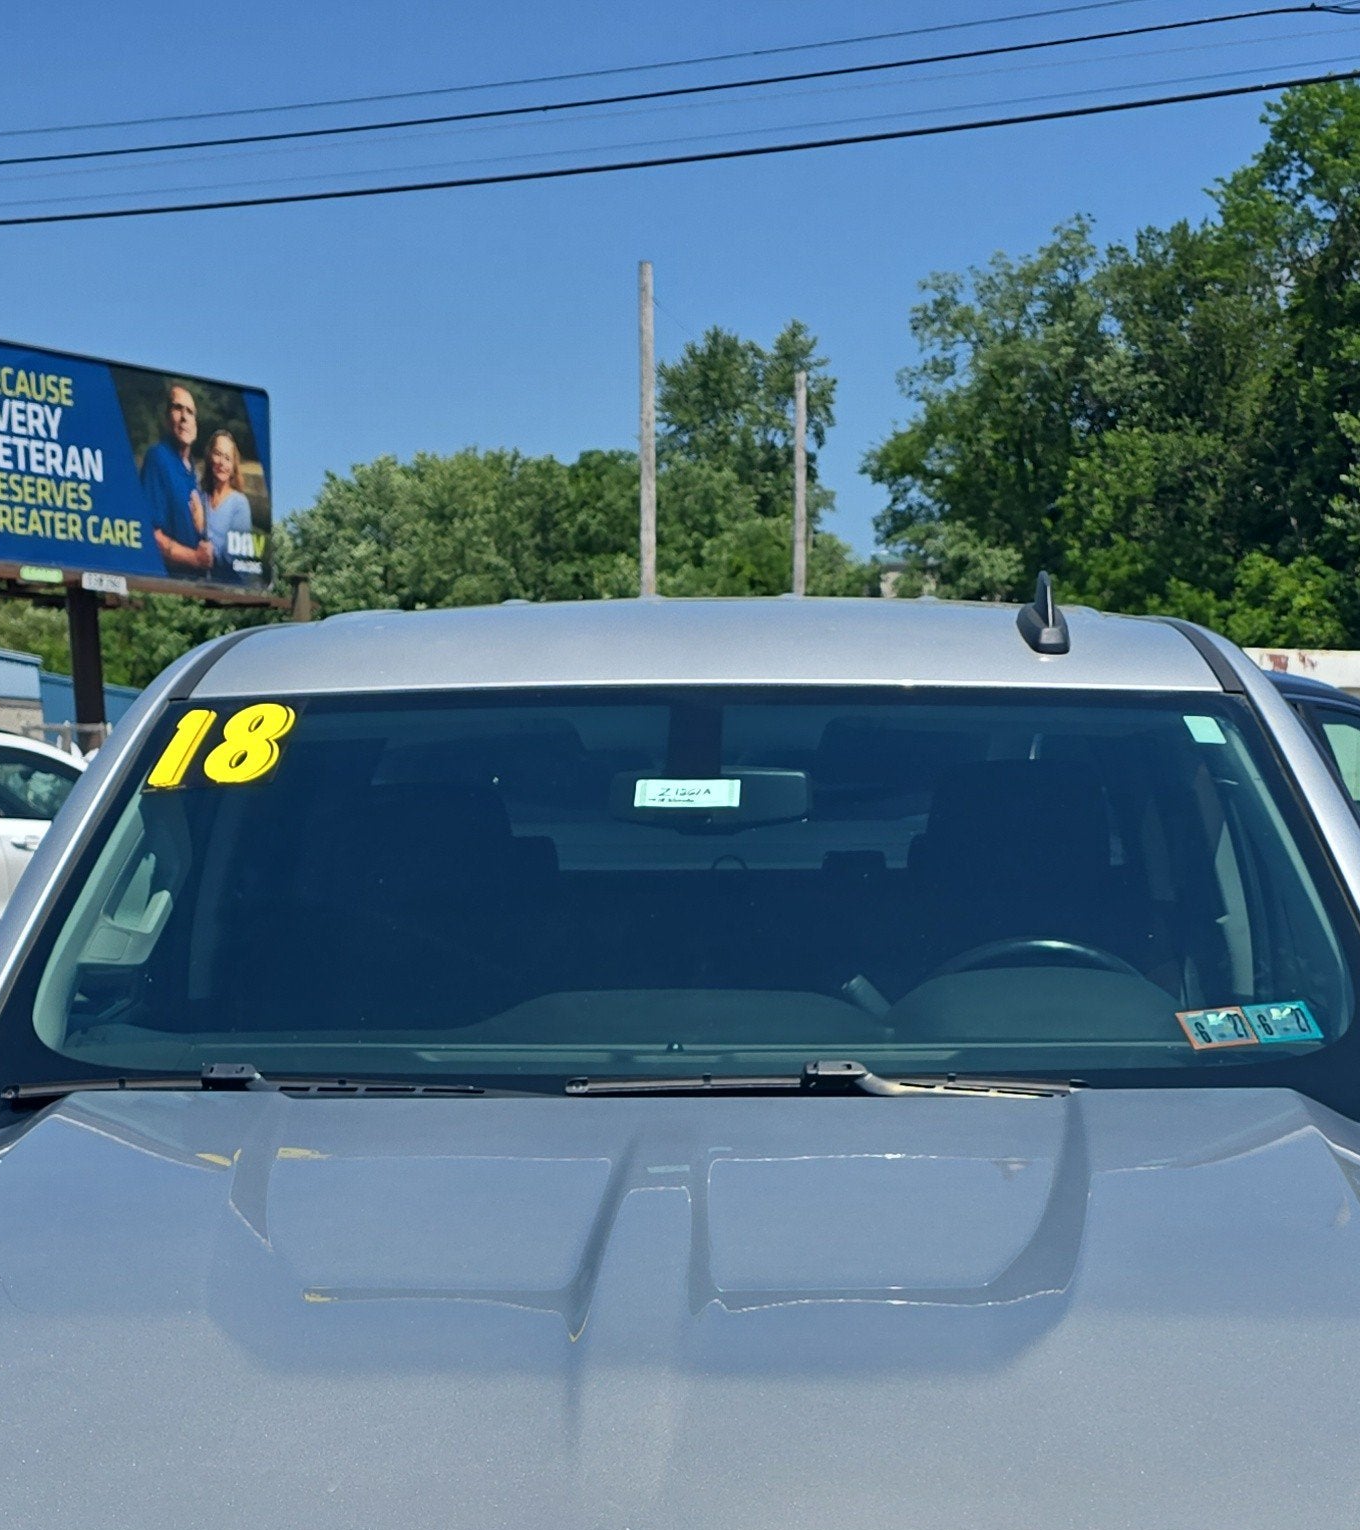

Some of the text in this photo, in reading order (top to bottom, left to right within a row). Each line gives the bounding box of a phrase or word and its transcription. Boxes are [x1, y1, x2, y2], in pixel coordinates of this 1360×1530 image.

[87, 515, 143, 549] CARE
[147, 703, 296, 787] 18
[1194, 1021, 1213, 1043] 6
[1256, 1013, 1274, 1036] 6
